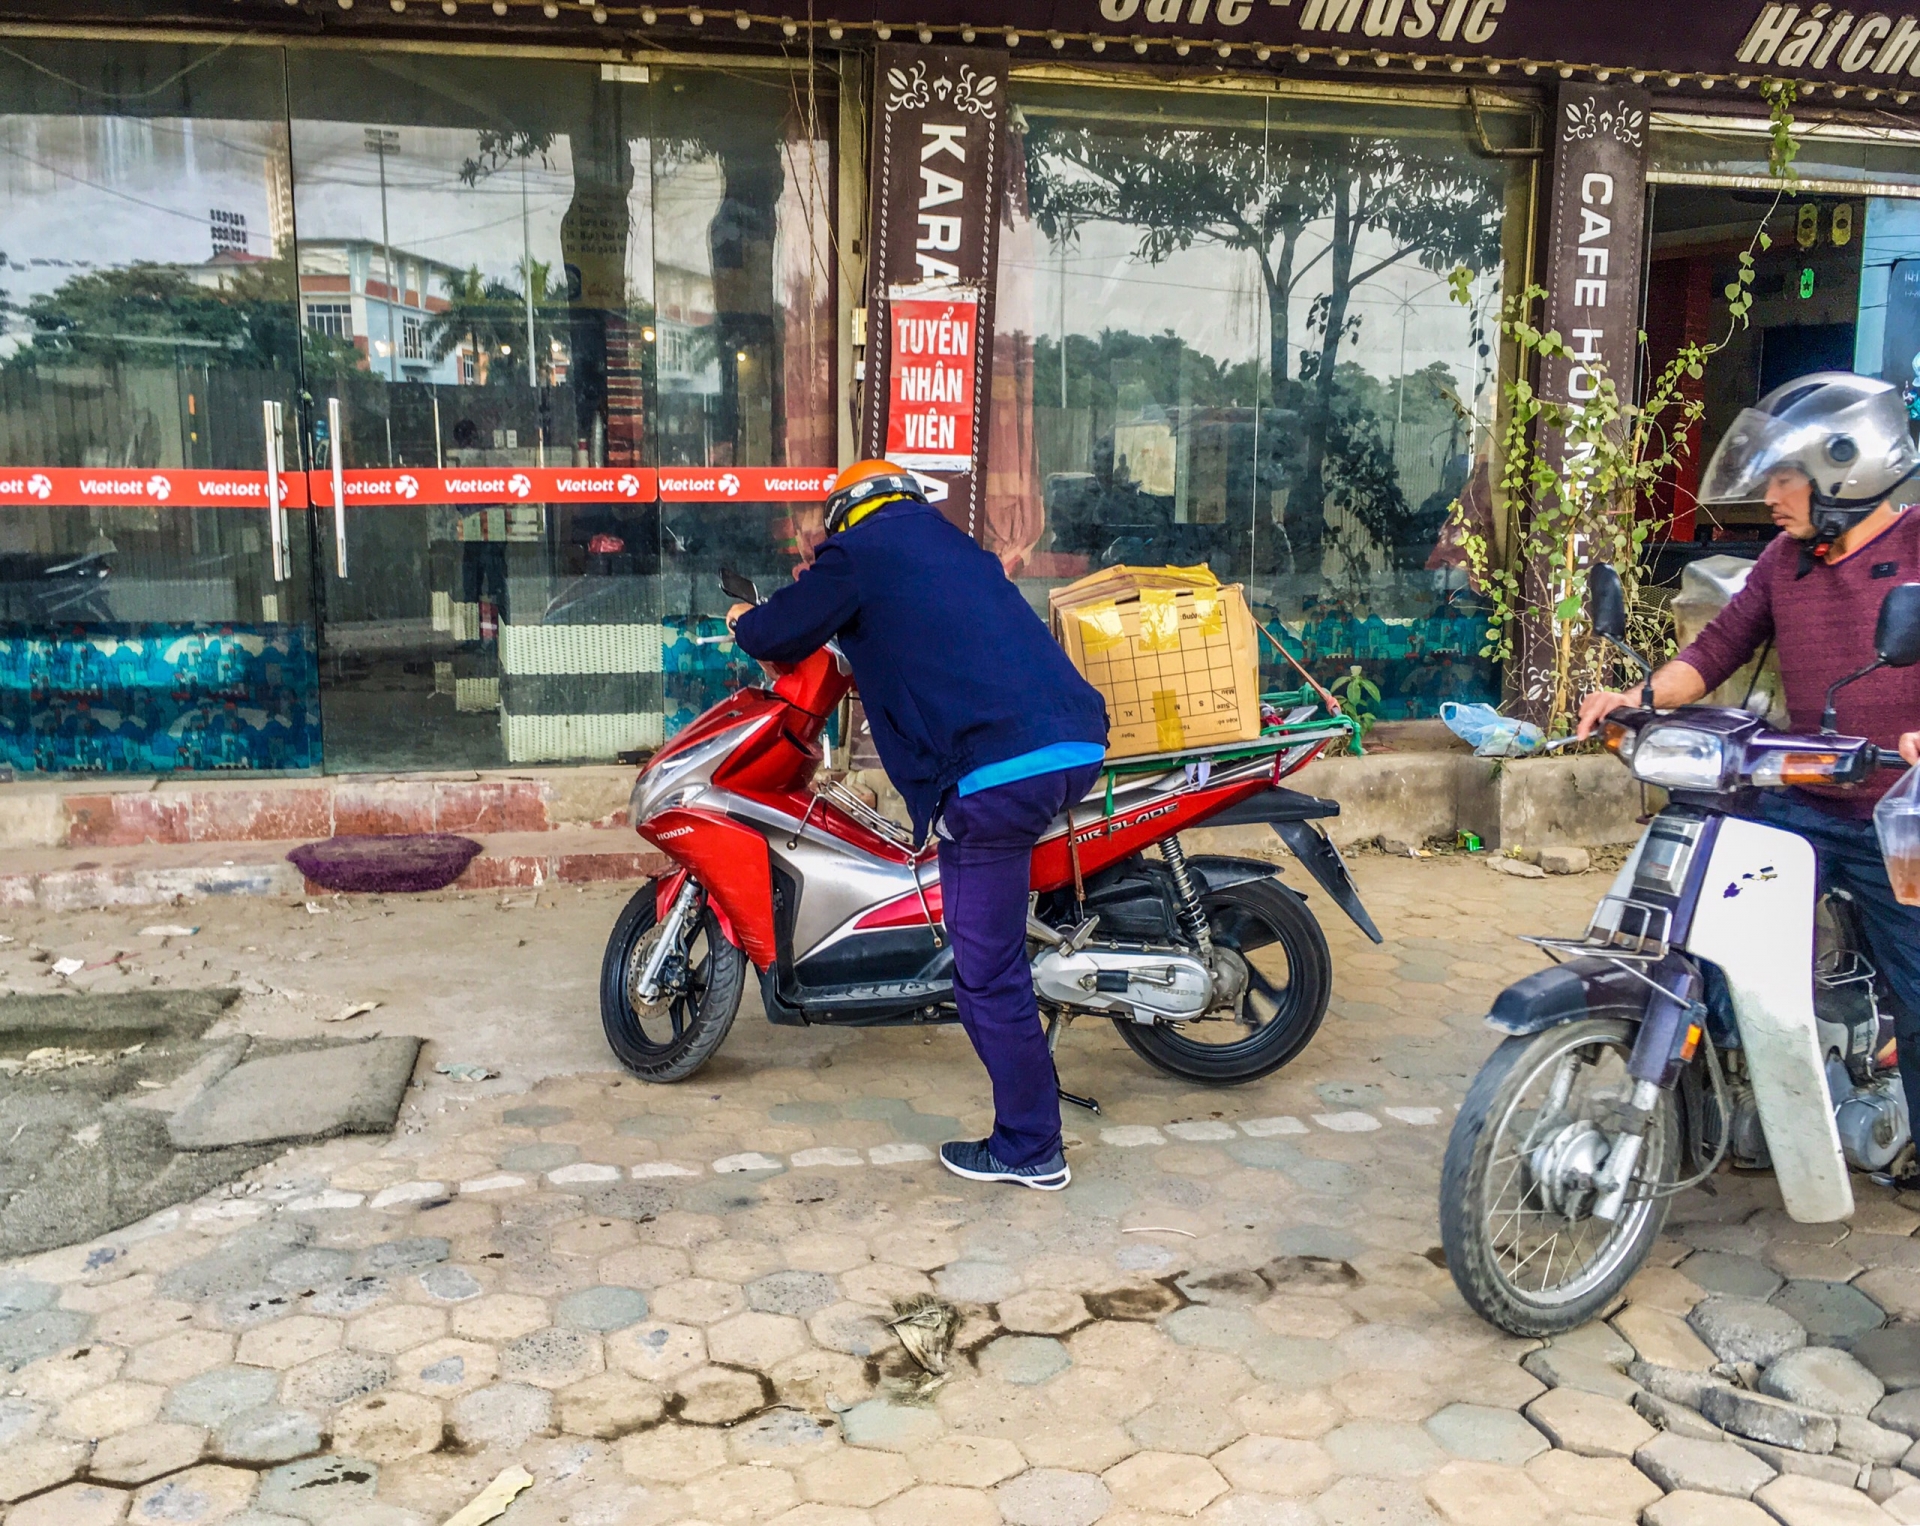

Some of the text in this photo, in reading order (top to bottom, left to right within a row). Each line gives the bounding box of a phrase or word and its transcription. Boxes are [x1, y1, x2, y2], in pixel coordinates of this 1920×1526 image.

[1574, 172, 1614, 307] CAFE
[897, 306, 969, 356] TUYỂN
[900, 360, 963, 403] NHÂN
[904, 407, 955, 449] VIÊN
[79, 479, 143, 495] Vietlott
[198, 480, 261, 496] Vietlott
[445, 479, 505, 493] Vietlott
[556, 478, 615, 493] Vietlott
[659, 478, 715, 492] Vietlott
[764, 478, 820, 492] Vietlott
[1109, 802, 1178, 832] BLADE
[656, 825, 695, 840] HONDA
